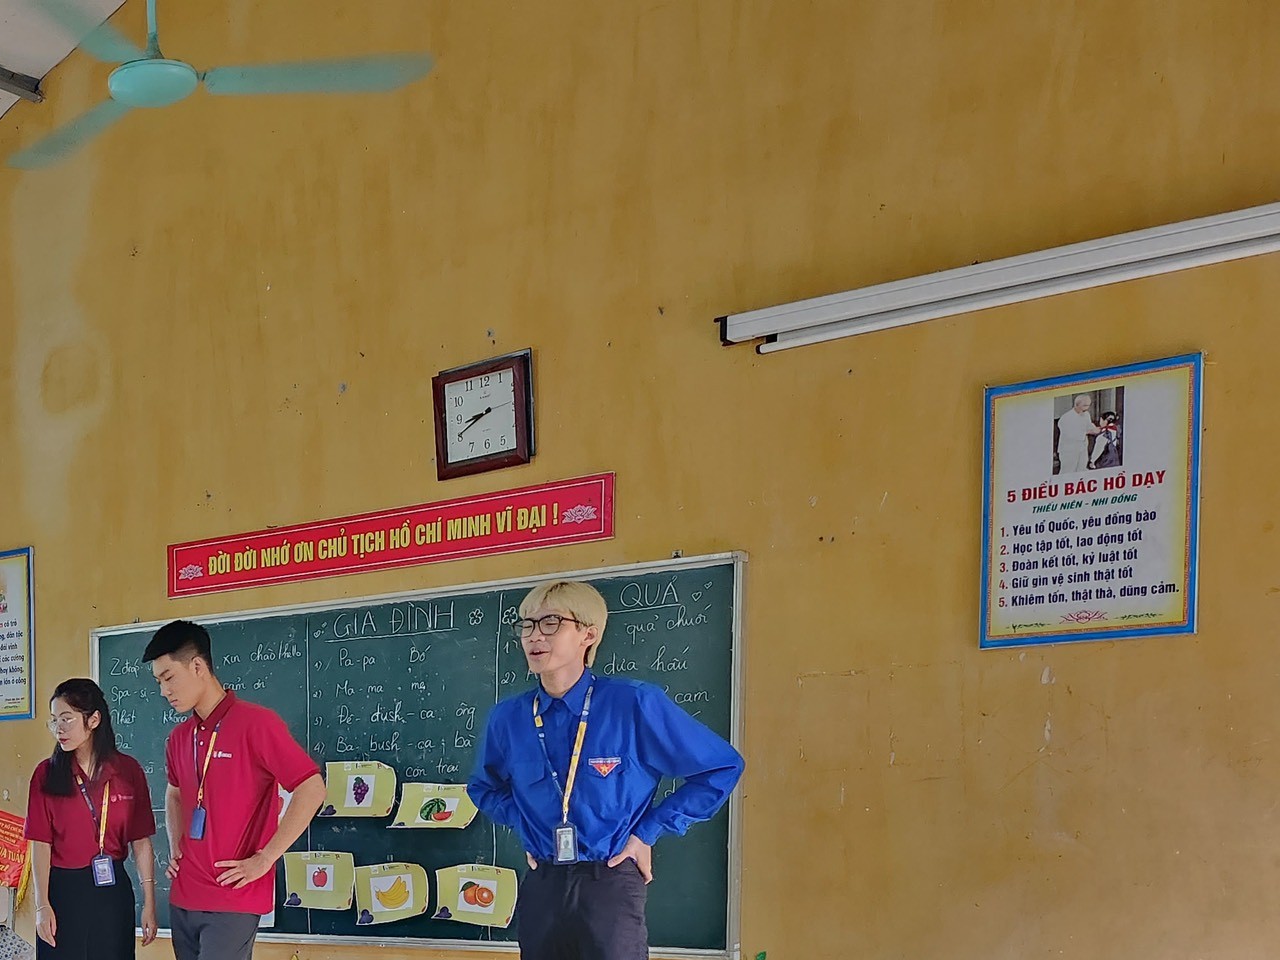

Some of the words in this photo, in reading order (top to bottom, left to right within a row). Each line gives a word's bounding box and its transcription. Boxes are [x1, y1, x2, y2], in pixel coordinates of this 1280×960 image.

[479, 375, 490, 388] 12
[454, 396, 464, 407] 10
[1007, 489, 1017, 503] 5
[1021, 480, 1059, 502] ĐIỀU
[1064, 478, 1098, 497] BÁC
[1103, 469, 1126, 494] HỒ
[1131, 469, 1167, 489] DẠY
[1091, 497, 1109, 508] NHI
[1000, 527, 1009, 538] 1.
[1012, 523, 1032, 537] Yêu
[1048, 514, 1078, 533] Quốc,
[1081, 516, 1102, 531] yêu
[1135, 509, 1157, 522] bào
[207, 548, 232, 576] ĐỜI
[233, 545, 258, 573] ĐỜI
[261, 540, 291, 568] NHỚ
[294, 537, 314, 563] ƠN
[317, 527, 348, 560] CHỦ
[351, 529, 385, 561] TỊCH
[389, 519, 411, 550] HỒ
[414, 515, 443, 545] CHÍ
[446, 511, 491, 542] MINH
[495, 505, 513, 534] VĨ
[516, 505, 547, 532] ĐẠI
[1000, 544, 1010, 556] 2.
[1012, 541, 1033, 556] Học
[1035, 539, 1053, 553] tập
[1055, 533, 1073, 550] tốt,
[1076, 535, 1094, 547] lao
[1097, 532, 1124, 548] động
[1127, 529, 1143, 542] tốt
[999, 562, 1009, 573] 3.
[1012, 559, 1039, 572] Đoàn
[1042, 555, 1059, 569] kết
[1062, 552, 1079, 567] tốt,
[1098, 549, 1120, 563] luật
[1123, 548, 1138, 560] tốt
[999, 579, 1008, 590] 4.
[1051, 573, 1064, 586] vệ
[1067, 571, 1090, 584] sinh
[1094, 569, 1115, 582] thật
[1118, 566, 1133, 579] tốt
[998, 597, 1008, 608] 5.
[1011, 593, 1045, 607] Khiêm
[1071, 587, 1093, 603] thật
[1119, 582, 1147, 598] dũng
[1150, 580, 1180, 595] cảm.
[333, 610, 376, 638] GIA
[388, 600, 454, 634] ĐÌNH
[674, 689, 710, 704] cam
